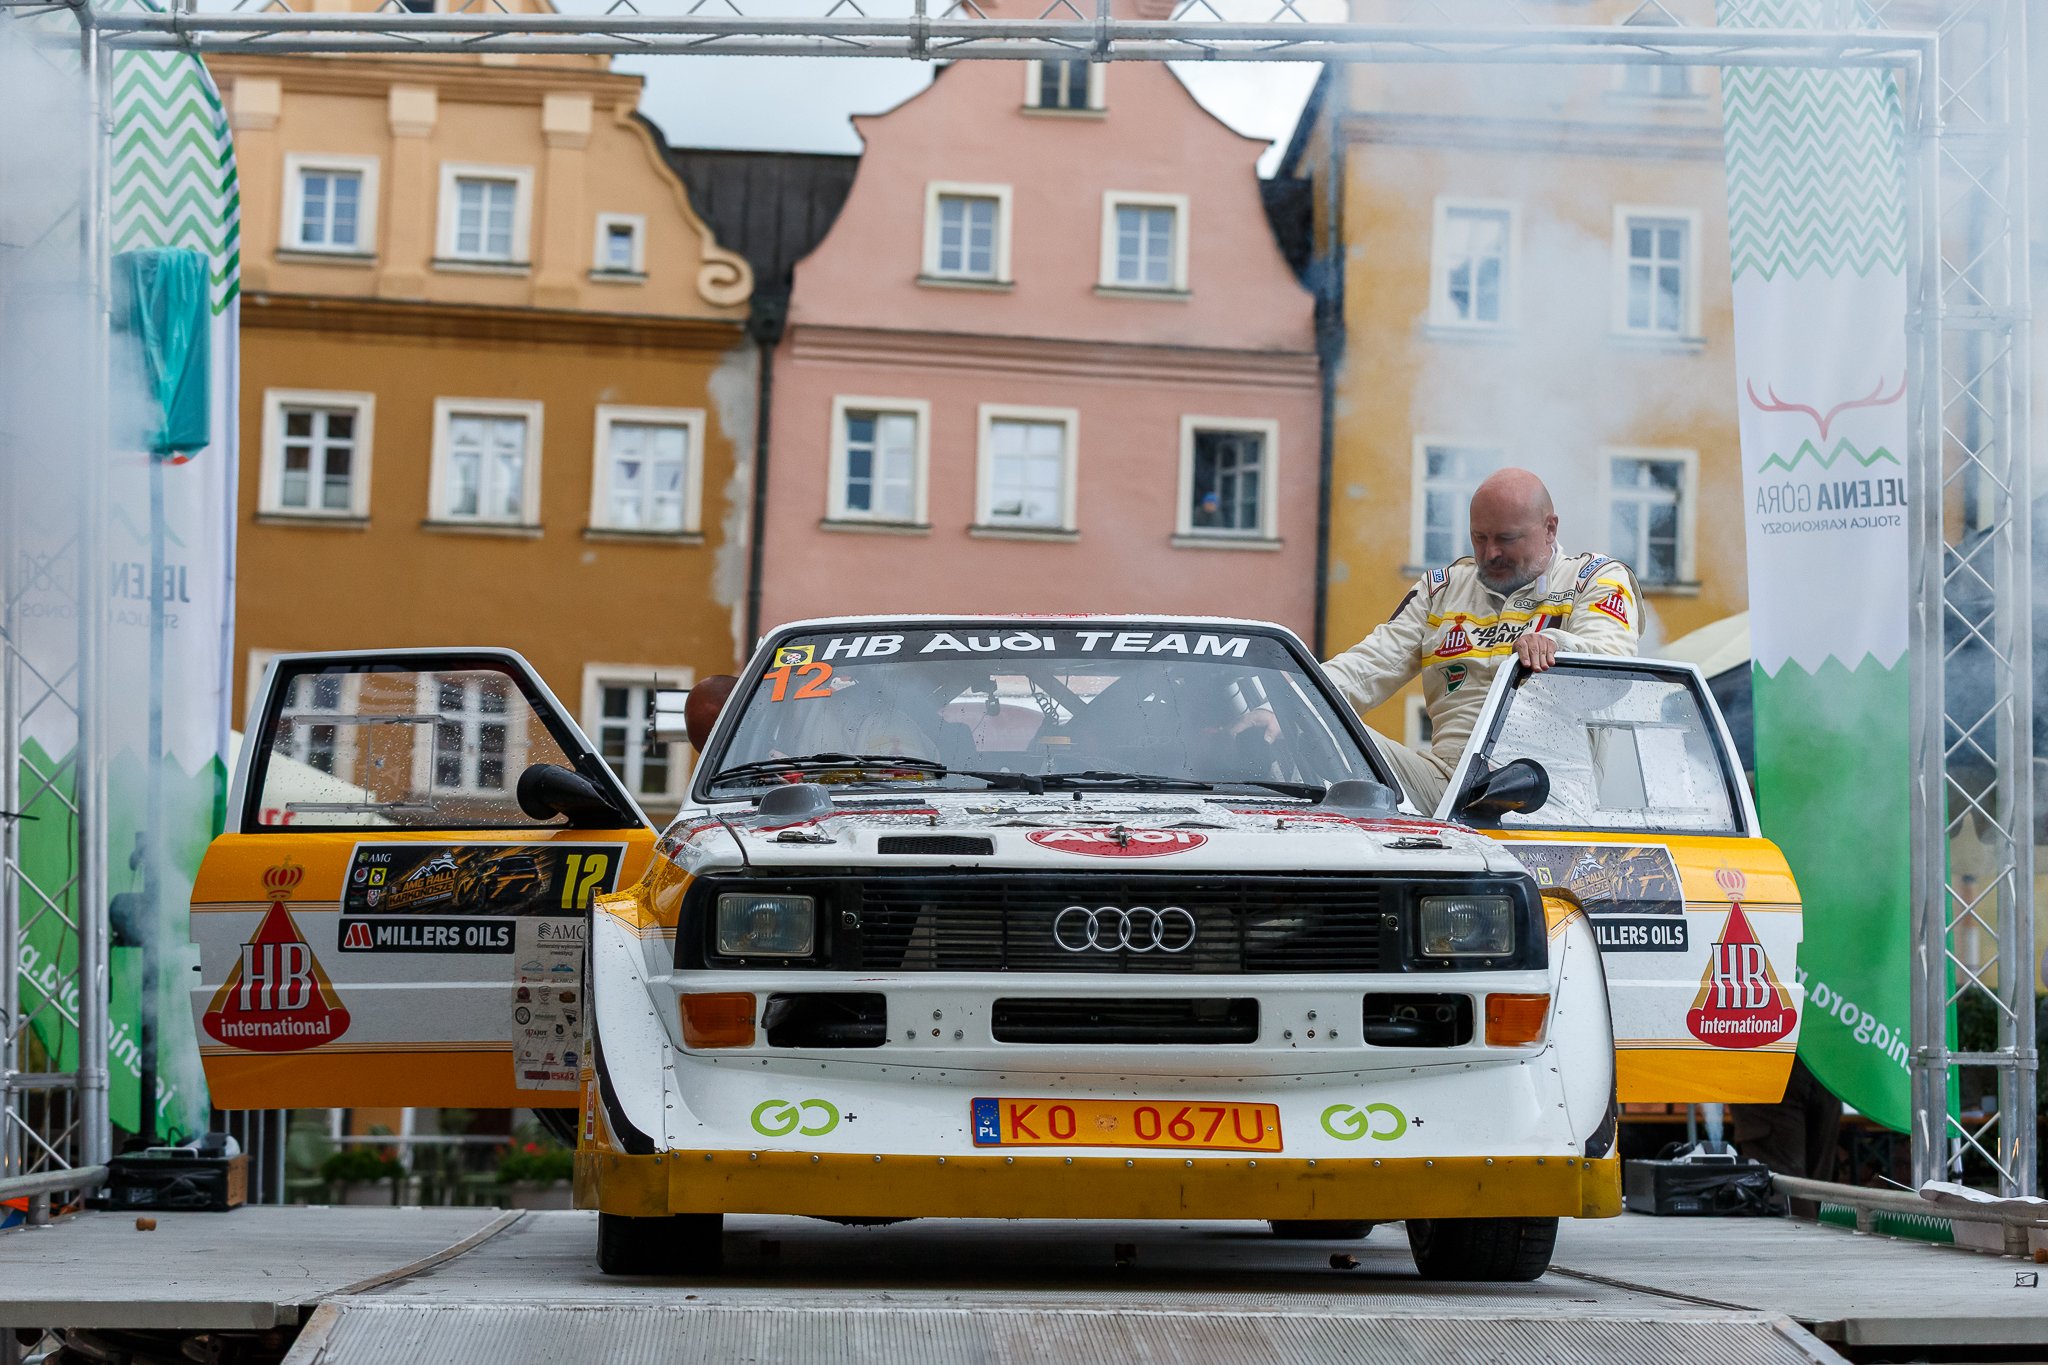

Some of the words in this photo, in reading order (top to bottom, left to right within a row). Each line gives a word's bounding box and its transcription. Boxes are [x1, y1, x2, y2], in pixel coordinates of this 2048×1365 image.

[1606, 593, 1625, 614] HB
[1445, 631, 1466, 649] HB
[1471, 625, 1497, 638] HB
[823, 634, 905, 660] HB
[919, 632, 1056, 654] Audi
[1076, 632, 1251, 659] TEAM
[763, 661, 833, 702] 12
[368, 852, 391, 863] AMG
[1528, 852, 1547, 862] AMG
[426, 870, 458, 886] RALLY
[561, 853, 609, 909] 12
[376, 925, 460, 947] MILLERS
[465, 926, 509, 947] OILS
[1651, 925, 1684, 945] OILS
[240, 942, 315, 1012] HB
[1711, 942, 1768, 1010] HB
[221, 1015, 331, 1038] international
[1699, 1015, 1783, 1035] international
[979, 1126, 998, 1138] PL
[1134, 1106, 1265, 1144] 067U
